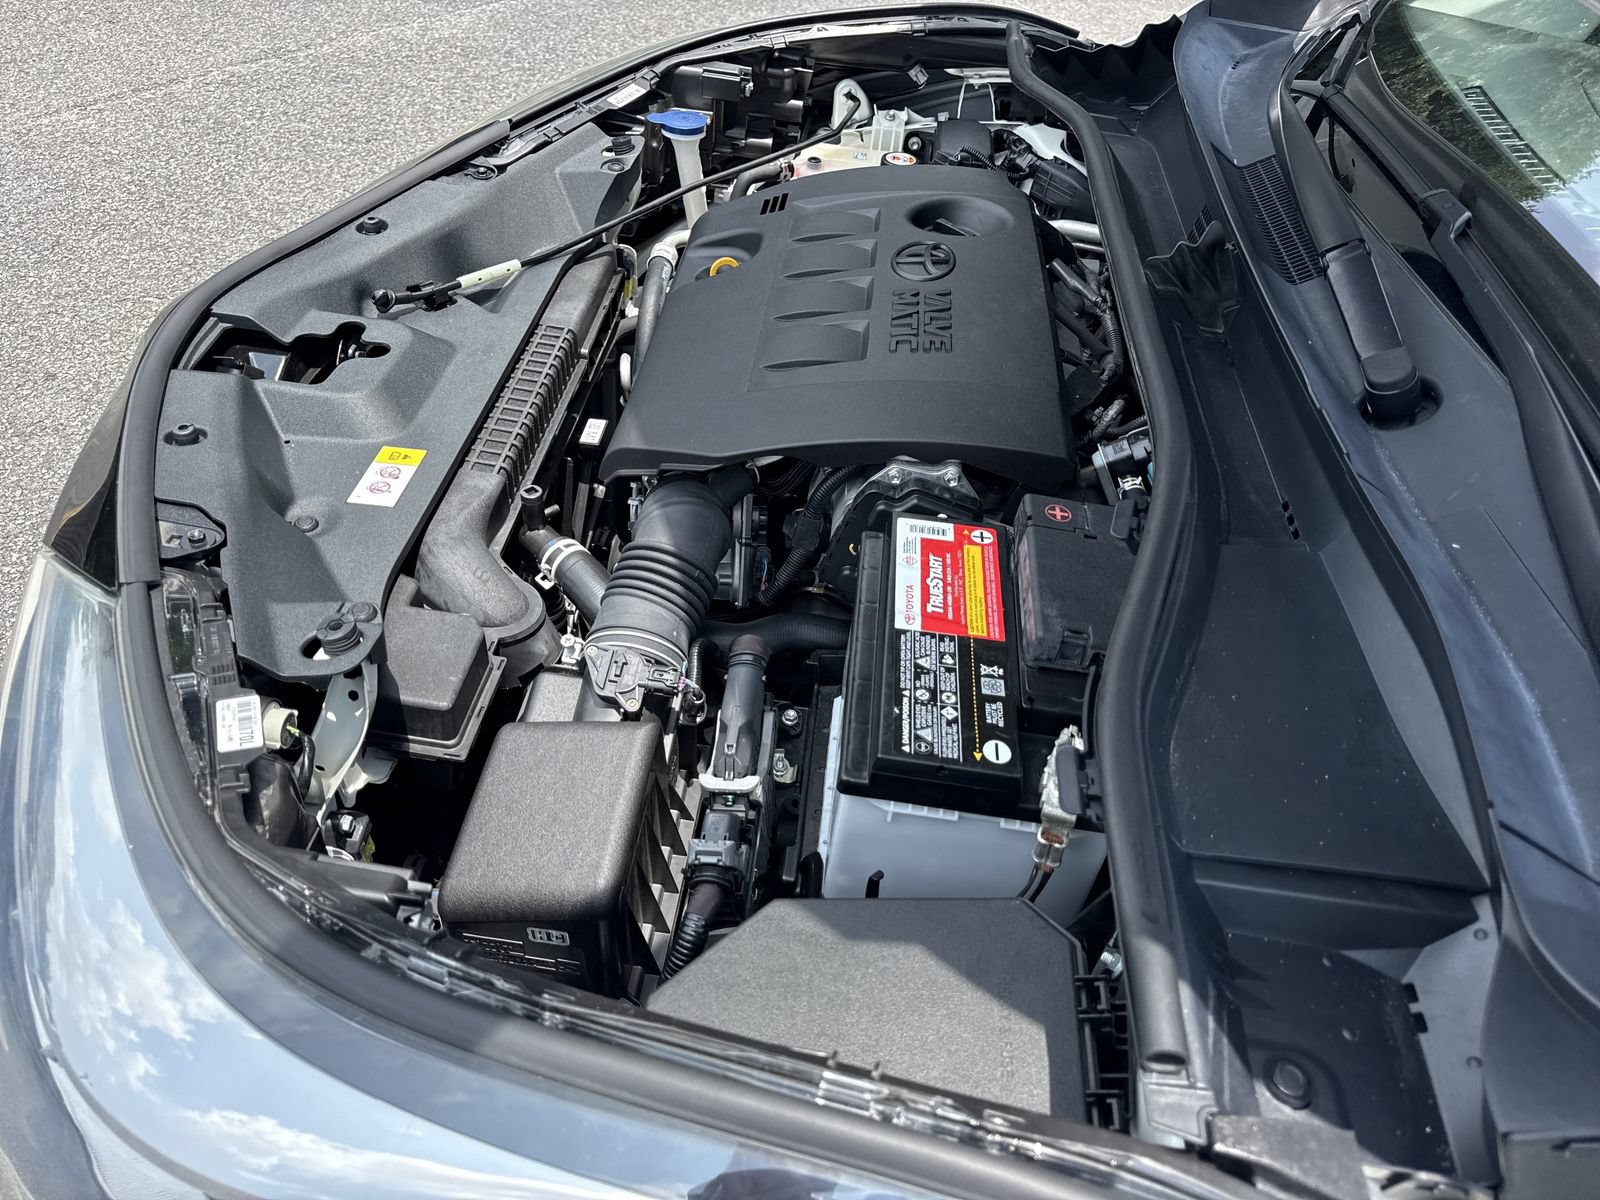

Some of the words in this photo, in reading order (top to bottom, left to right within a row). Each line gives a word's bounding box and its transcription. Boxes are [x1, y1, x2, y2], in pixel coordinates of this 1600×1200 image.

[889, 290, 920, 353] MATIC
[923, 289, 952, 353] VALVE
[905, 584, 914, 613] TOYOTA
[239, 730, 254, 747] 70L
[901, 697, 910, 744] DANGER/POISON
